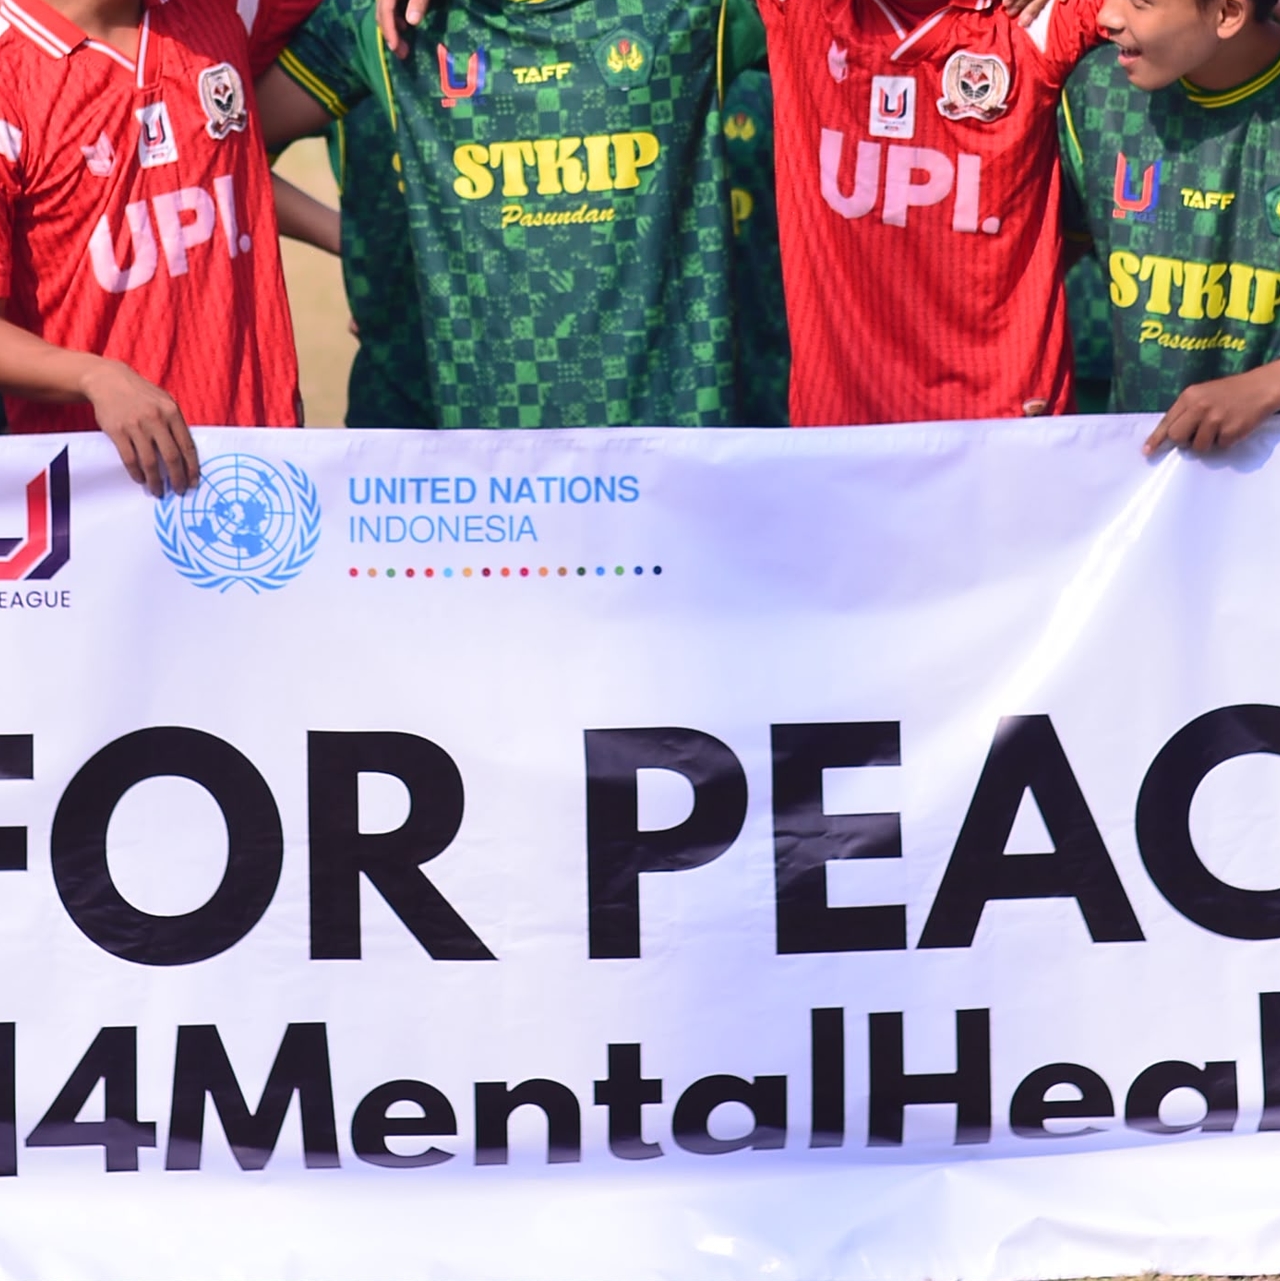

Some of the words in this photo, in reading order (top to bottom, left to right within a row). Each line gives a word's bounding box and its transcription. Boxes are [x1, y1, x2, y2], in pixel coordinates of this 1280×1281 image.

[512, 62, 573, 85] TAFF
[452, 131, 661, 201] STKIP
[1180, 187, 1236, 211] TAFF
[500, 202, 616, 230] Pasundan
[1138, 319, 1248, 352] Pasundan
[348, 476, 478, 505] UNITED
[488, 474, 641, 505] NATIONS
[349, 514, 539, 544] INDONESIA
